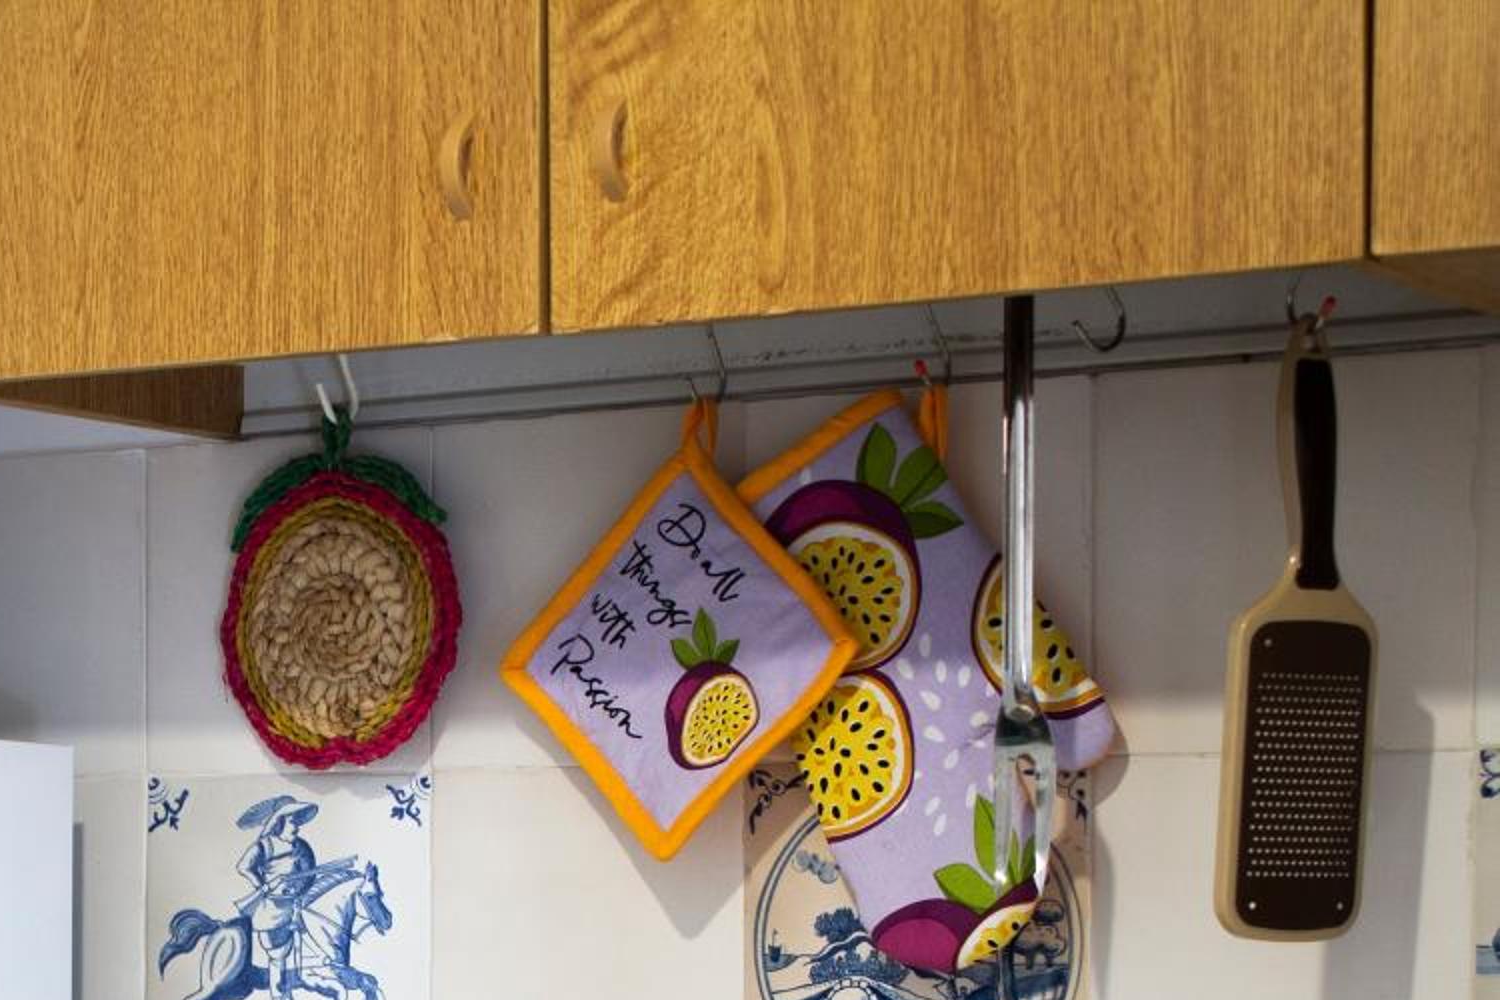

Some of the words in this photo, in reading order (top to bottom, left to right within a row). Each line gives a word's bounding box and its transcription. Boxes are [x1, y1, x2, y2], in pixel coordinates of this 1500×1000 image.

[620, 540, 692, 628] things
[700, 561, 747, 602] all
[591, 594, 636, 649] with
[550, 633, 643, 739] Passion
